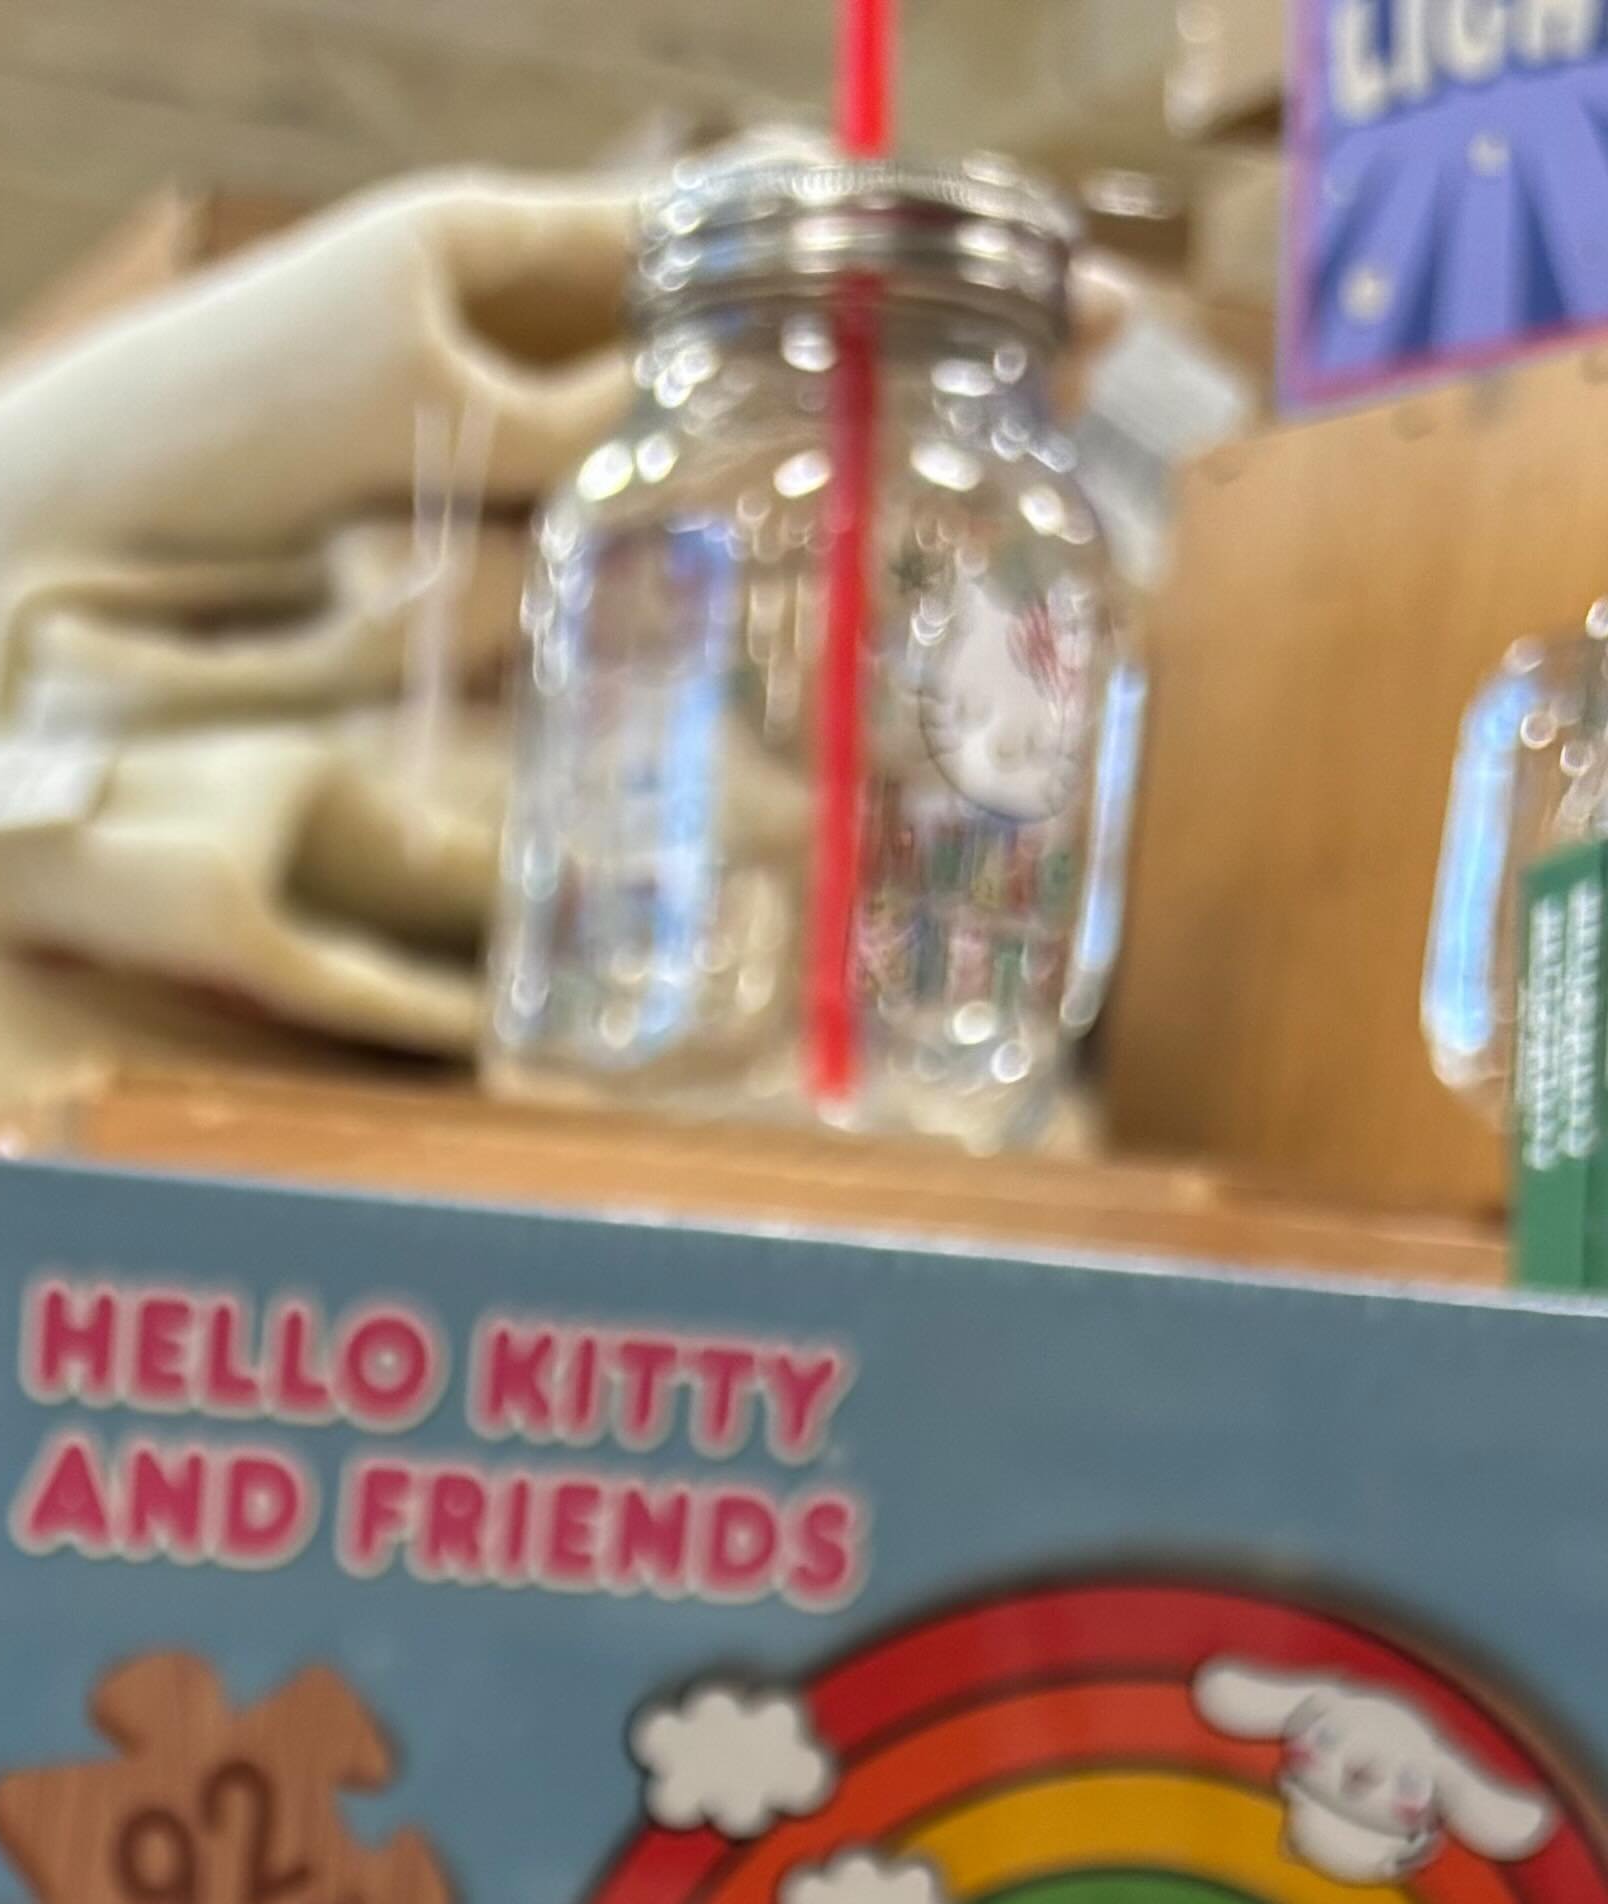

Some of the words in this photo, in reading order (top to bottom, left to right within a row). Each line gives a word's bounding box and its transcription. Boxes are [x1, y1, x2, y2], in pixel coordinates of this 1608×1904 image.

[26, 1280, 440, 1425] HELLO
[472, 1318, 850, 1457] KITTY
[18, 1434, 314, 1564] AND
[342, 1456, 866, 1608] FRIENDS
